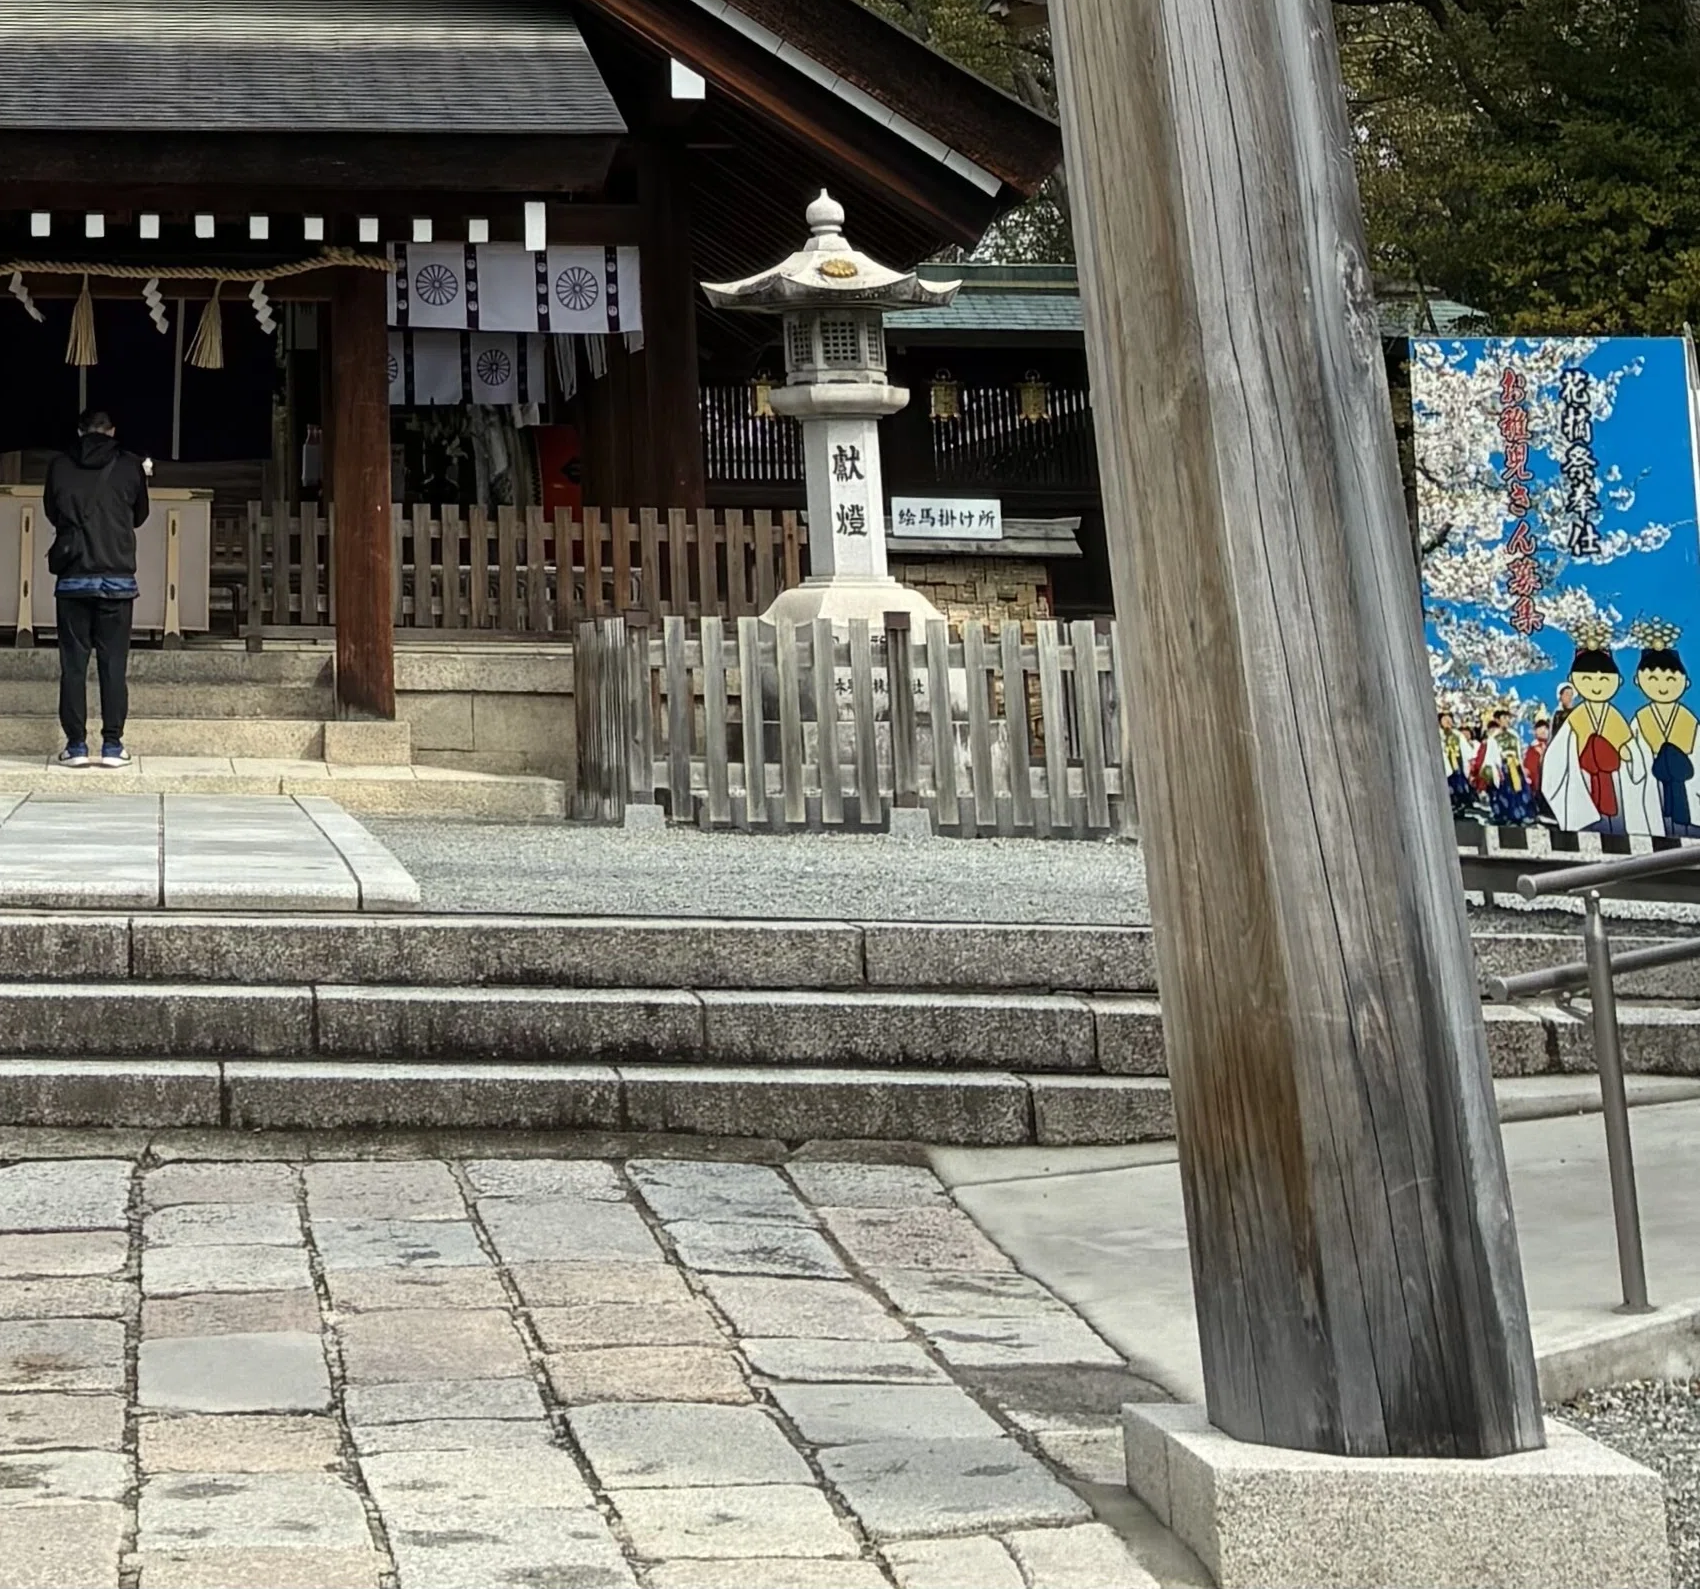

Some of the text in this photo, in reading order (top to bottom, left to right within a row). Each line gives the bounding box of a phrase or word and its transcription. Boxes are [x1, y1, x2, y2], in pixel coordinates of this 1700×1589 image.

[898, 507, 996, 529] 絵馬掛け所
[1498, 368, 1544, 635] お稚児さん募集
[1560, 369, 1600, 556] 花摘祭奉仕
